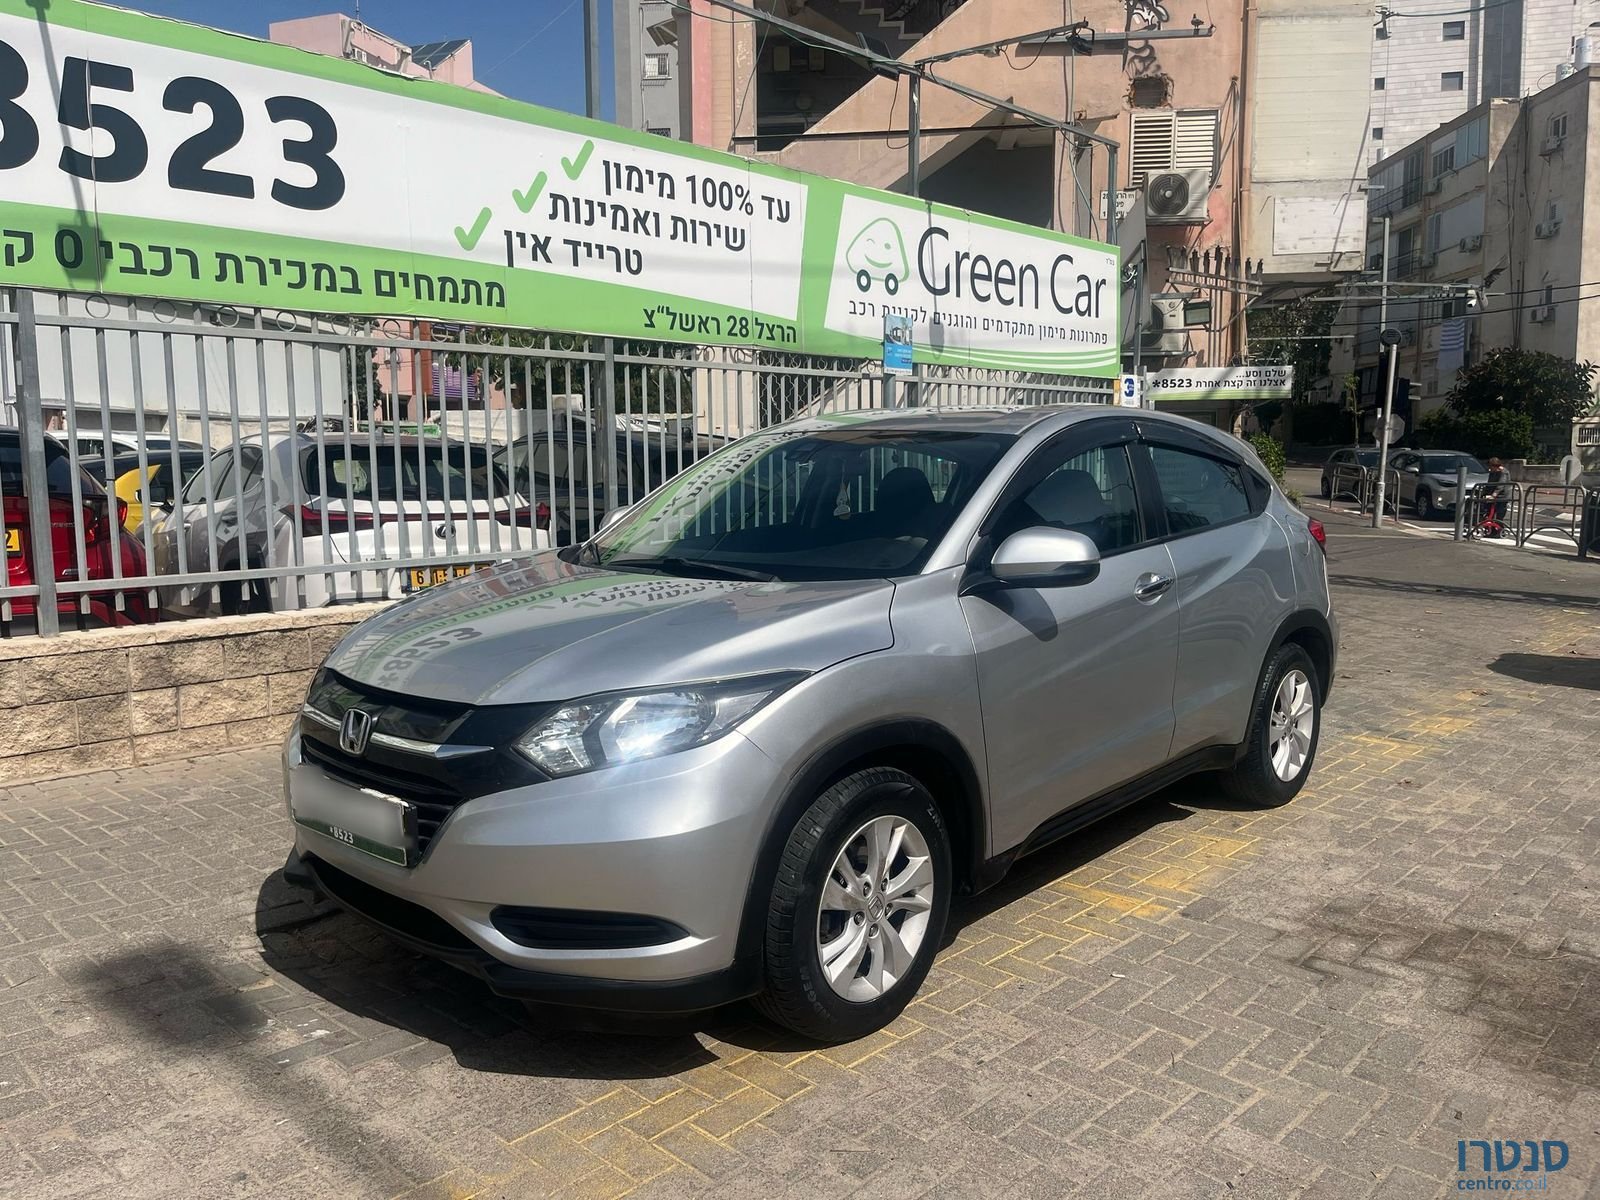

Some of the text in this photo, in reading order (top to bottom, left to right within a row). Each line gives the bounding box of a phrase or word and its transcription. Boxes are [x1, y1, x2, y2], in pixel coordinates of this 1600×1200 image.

[602, 159, 790, 223] עד 100% מימון
[548, 192, 746, 252] שירות ואמינות
[54, 228, 84, 269] 0
[503, 229, 643, 276] טרייד אין
[98, 240, 200, 281] רכבי
[214, 252, 363, 295] במכירת
[917, 226, 1107, 319] Green Car
[374, 269, 505, 309] מתמחים
[849, 300, 875, 317] רכב
[726, 315, 750, 338] 28
[754, 317, 797, 344] הרצל
[933, 311, 977, 329] והוגנים
[982, 318, 1035, 338] מתקדמים
[1039, 325, 1066, 341] מימון
[1069, 329, 1108, 345] פתרונות
[1246, 379, 1257, 387] זה
[1259, 378, 1286, 387] אצלנו
[1264, 368, 1287, 378] שלם
[1195, 380, 1220, 388] אחרת
[1223, 379, 1243, 389] קצת
